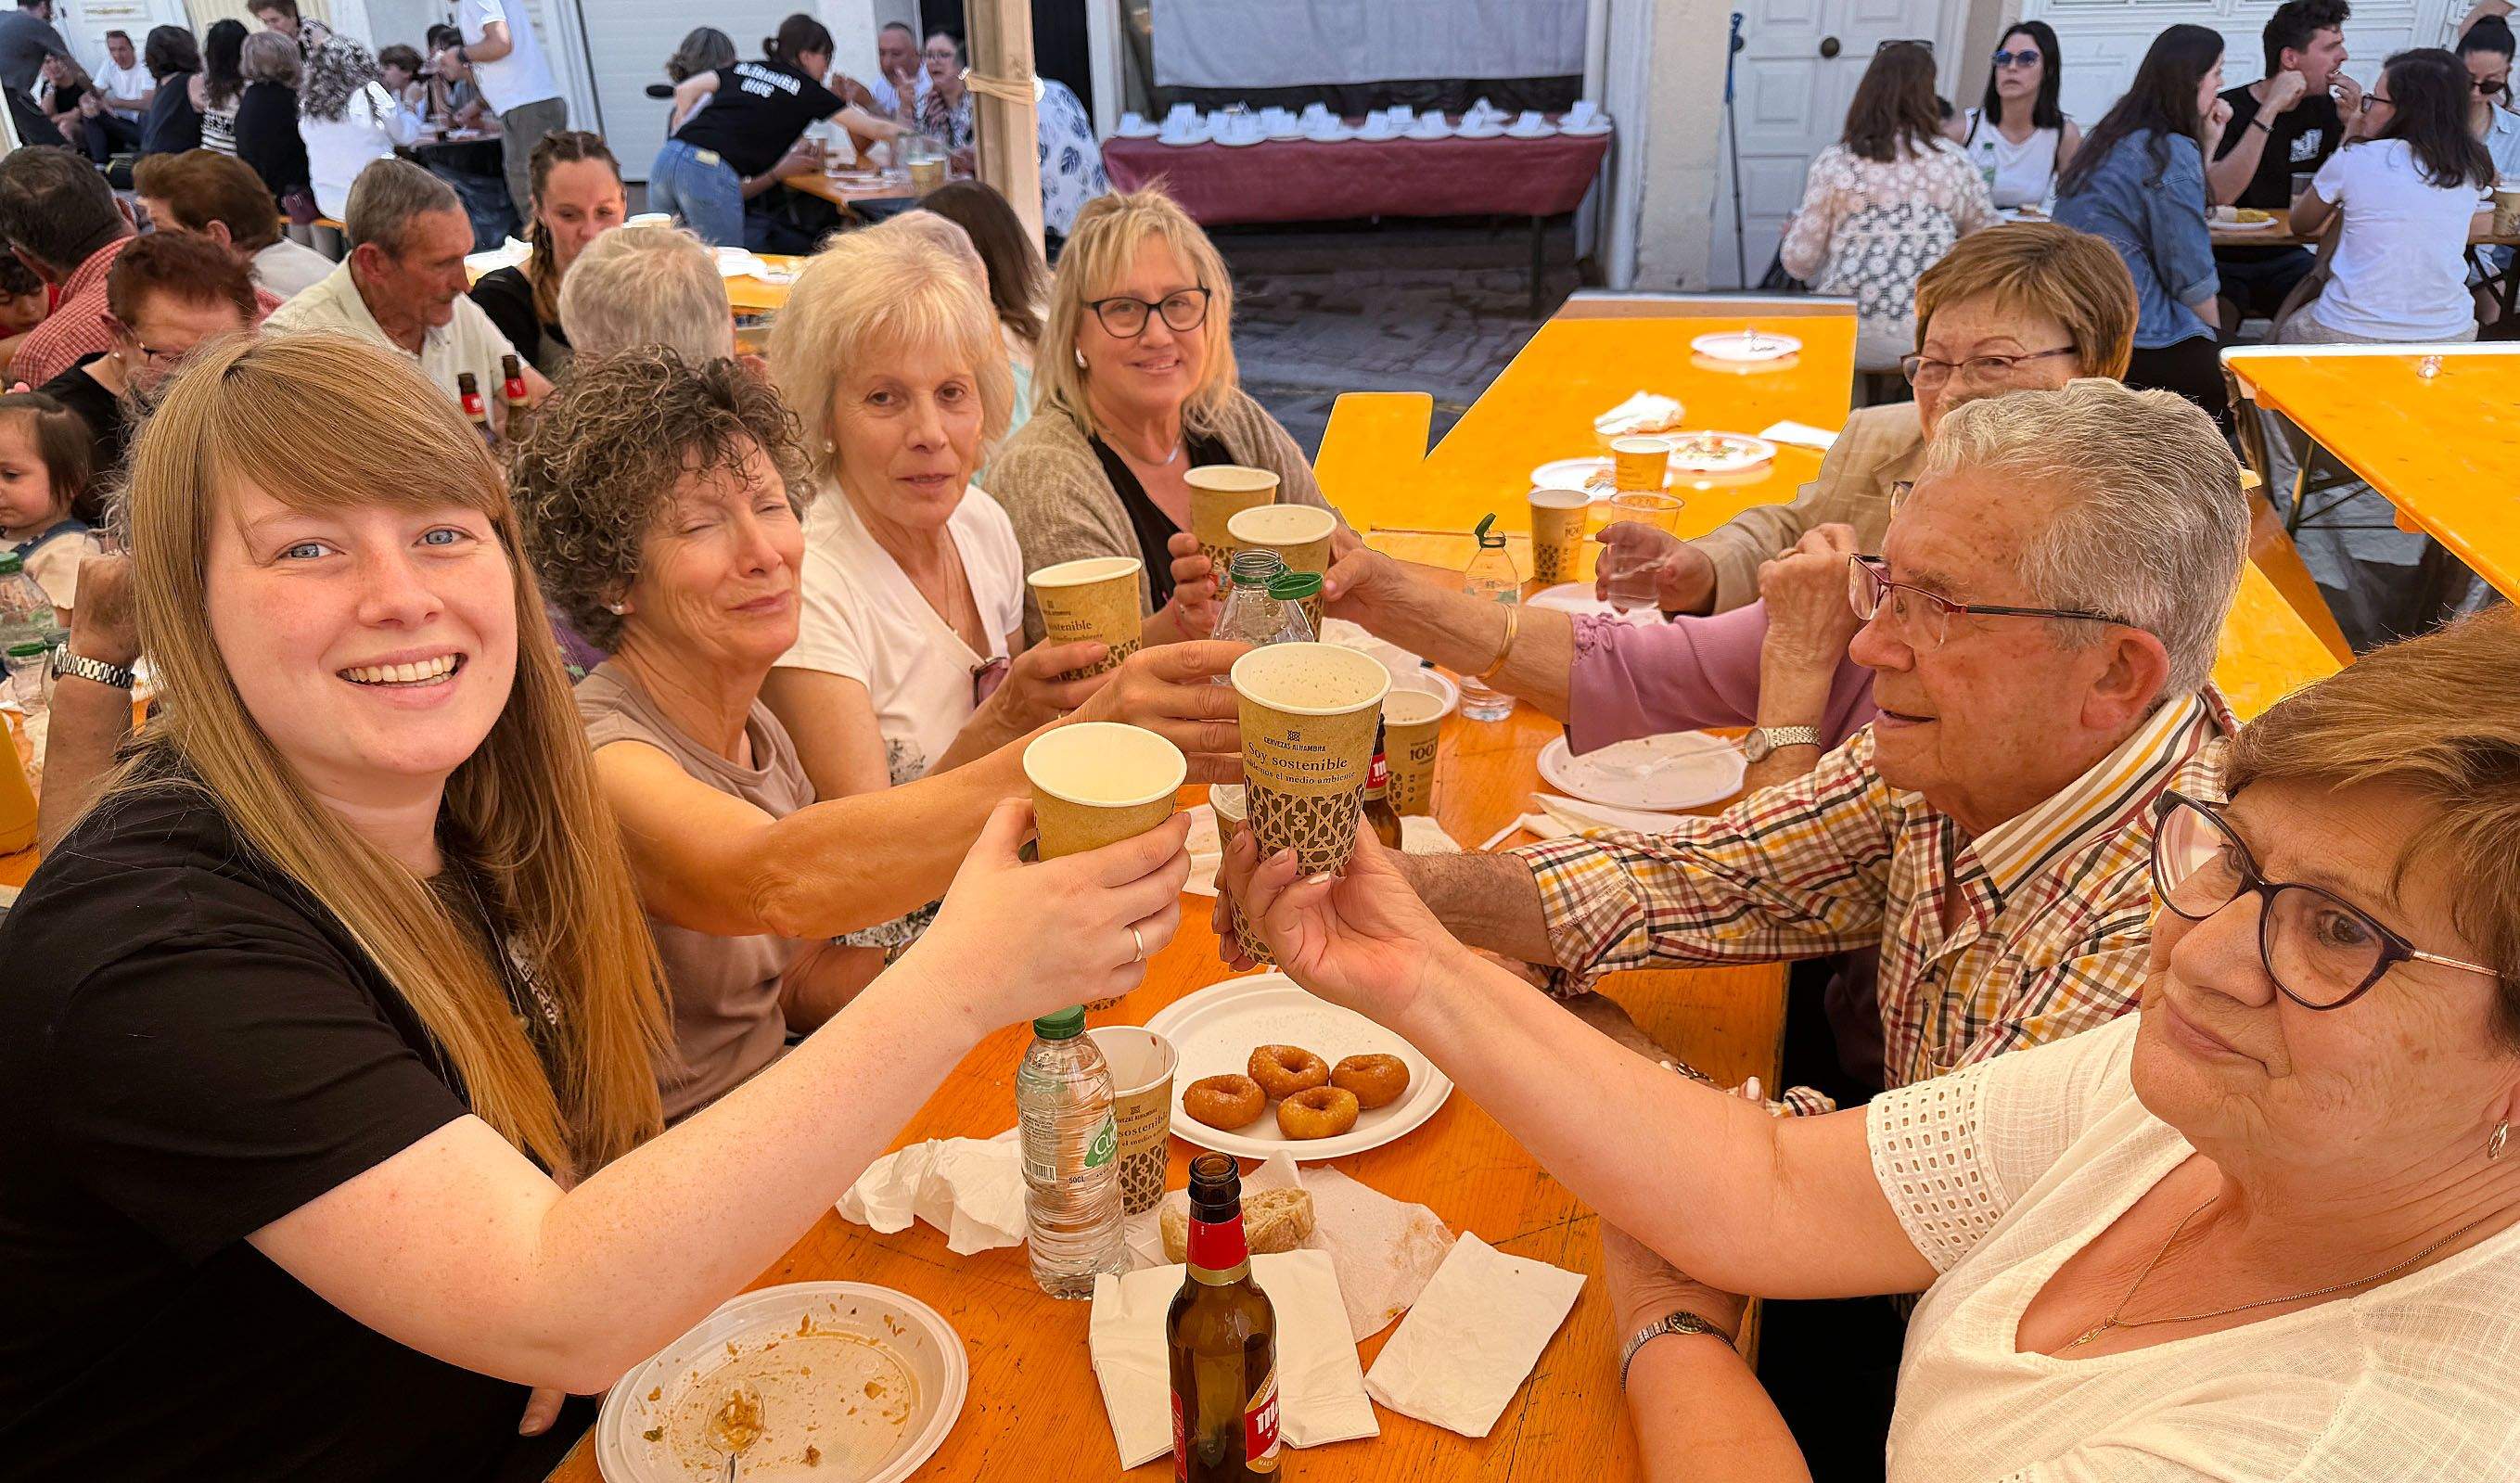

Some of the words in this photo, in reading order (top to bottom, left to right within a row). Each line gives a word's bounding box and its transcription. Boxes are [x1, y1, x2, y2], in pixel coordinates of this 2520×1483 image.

[1292, 744, 1326, 752] ALHAMBRA
[1410, 744, 1434, 761] 100
[1248, 742, 1268, 764] Soy
[1272, 757, 1348, 772] sostenible
[1286, 775, 1315, 785] medio
[1317, 772, 1355, 784] ambiente
